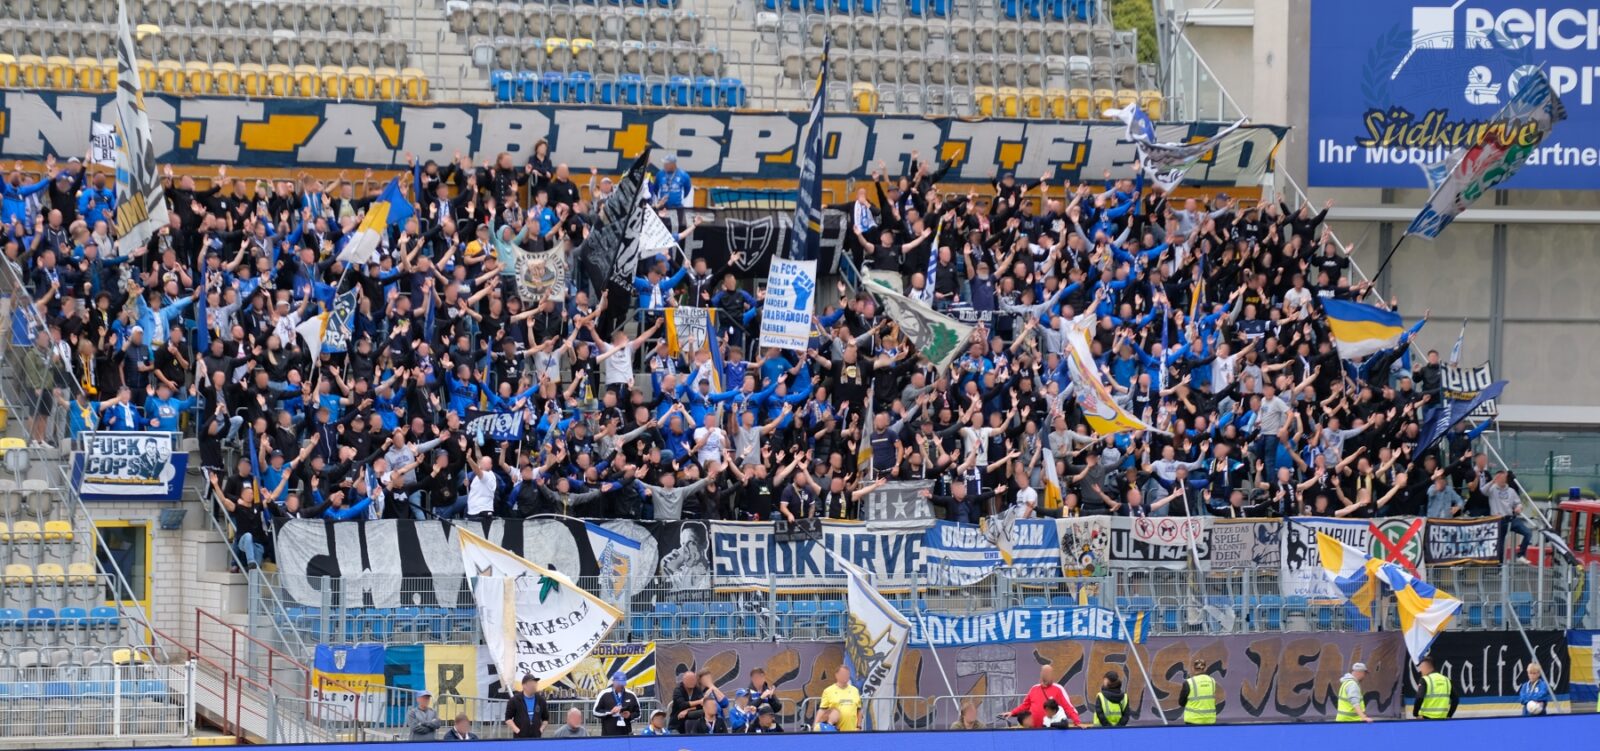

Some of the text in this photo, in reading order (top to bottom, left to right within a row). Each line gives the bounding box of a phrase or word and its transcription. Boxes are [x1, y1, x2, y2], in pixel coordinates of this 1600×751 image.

[1464, 65, 1502, 105] &
[646, 111, 1272, 188] SPORTFED
[1318, 139, 1358, 163] Ihr
[780, 262, 797, 276] FCC
[88, 437, 141, 456] FUCK
[85, 457, 141, 475] COPS
[940, 523, 1044, 549] UNBESAM
[1214, 533, 1242, 544] SPIEL
[1430, 522, 1499, 542] REFUGEES
[714, 530, 927, 577] SÜDKURVE
[1215, 550, 1241, 561] DEIN
[1430, 540, 1498, 559] WELCOME
[906, 606, 1131, 645] ÜDKURVE BLEIBT
[516, 620, 609, 675] FREUNDS
[1240, 637, 1400, 720] JENA
